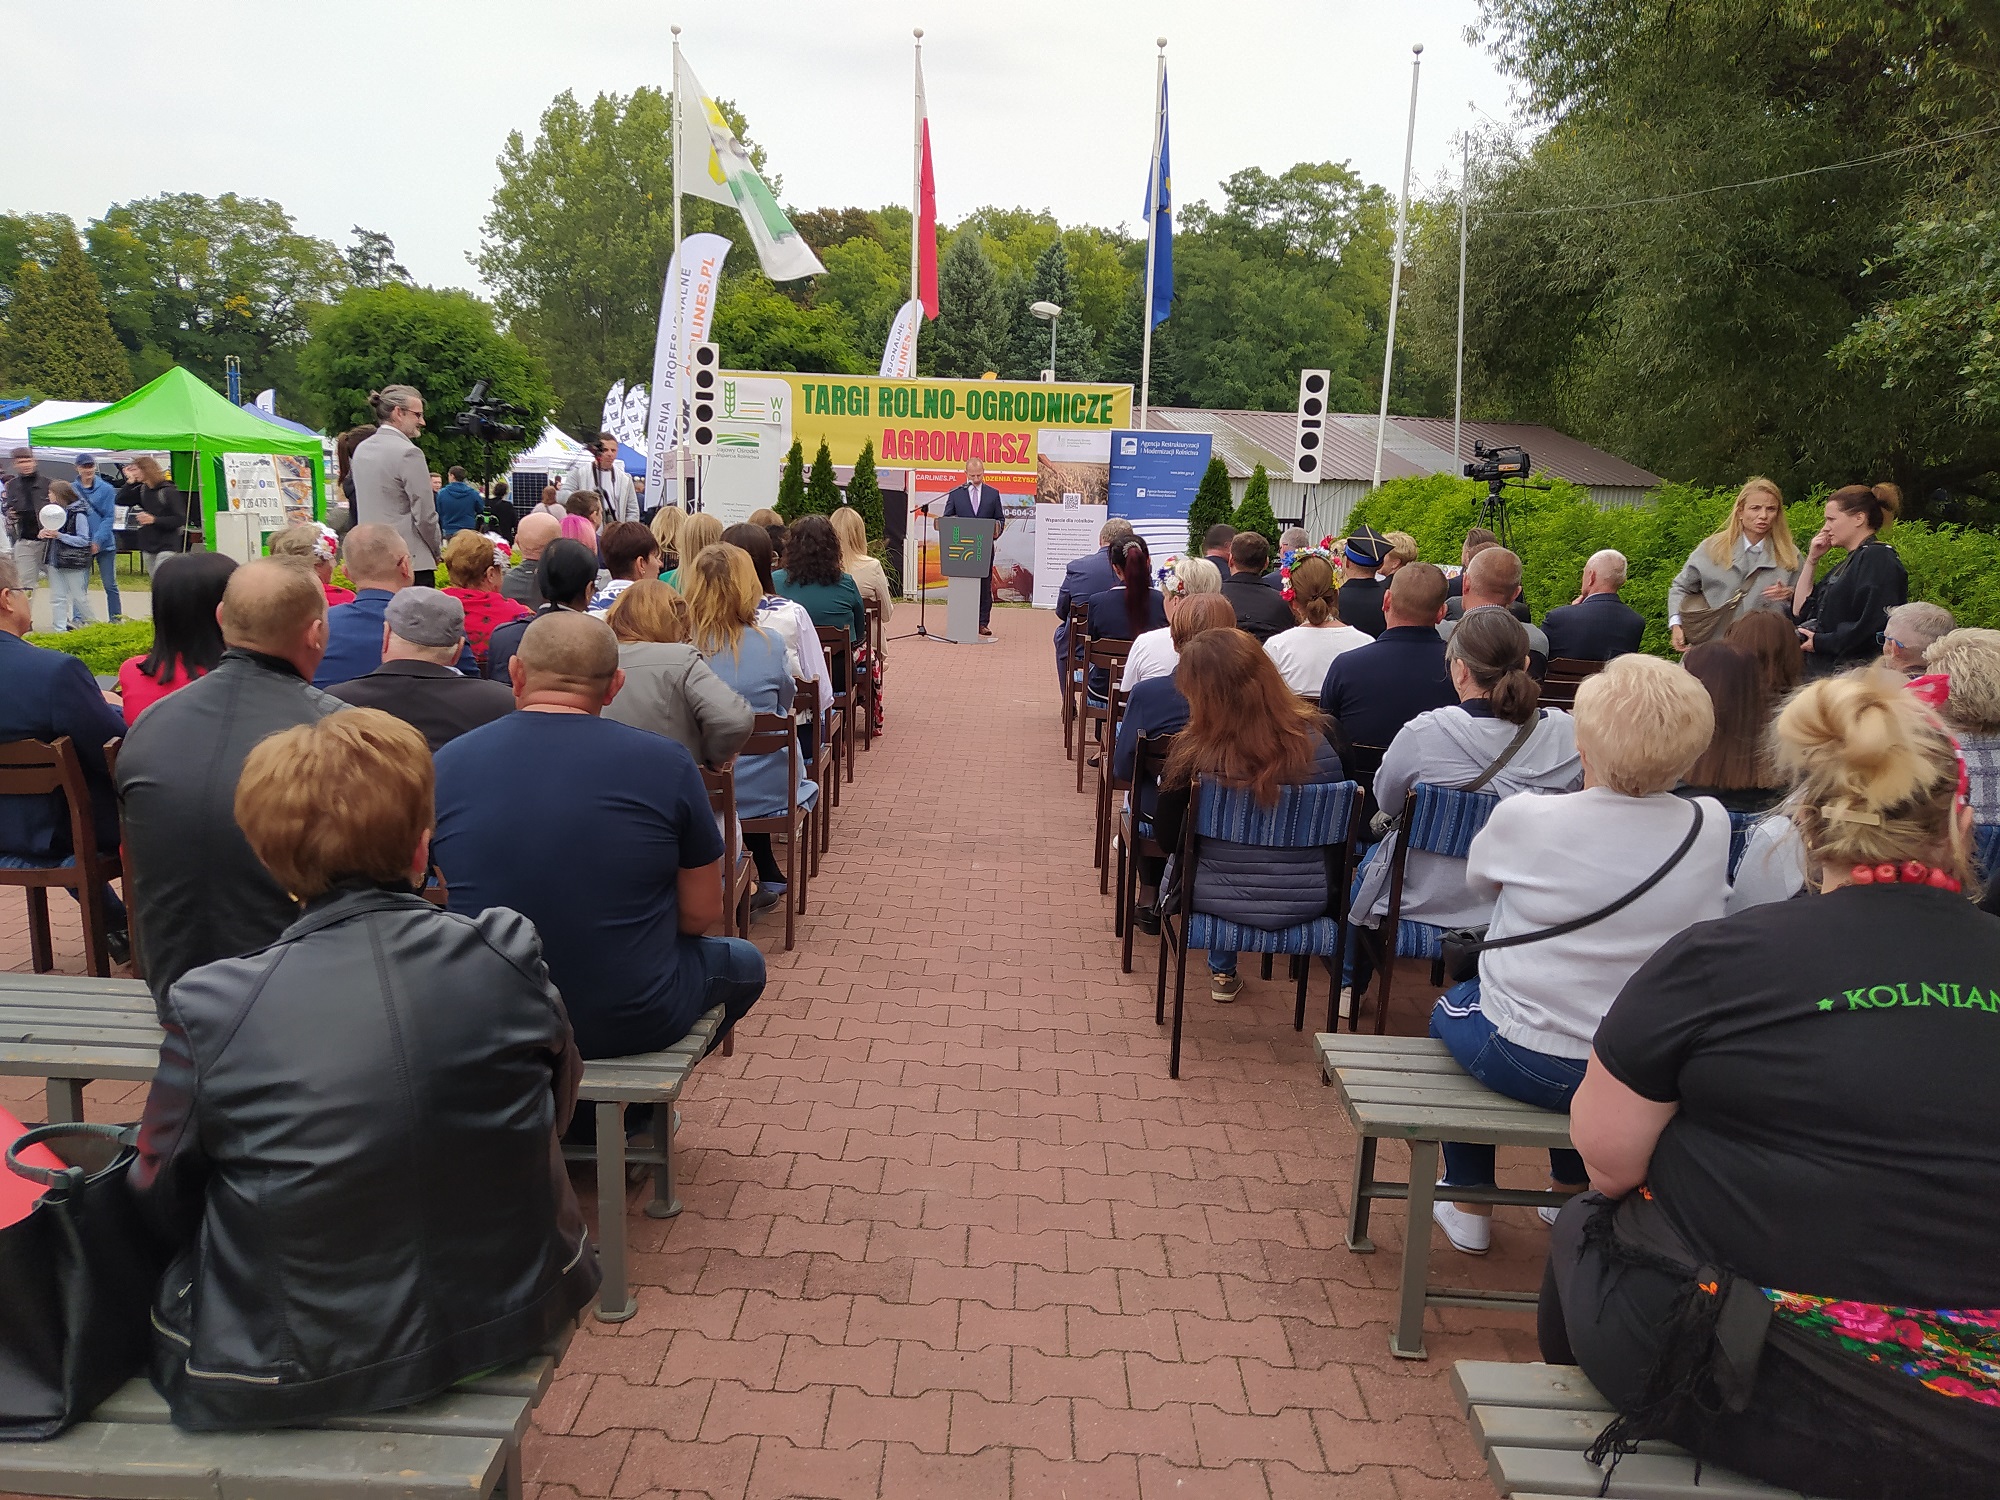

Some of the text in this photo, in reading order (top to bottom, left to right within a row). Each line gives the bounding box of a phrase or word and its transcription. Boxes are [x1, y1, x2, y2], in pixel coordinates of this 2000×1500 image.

[802, 384, 1114, 424] TARGI ROLNO-OGRODNICZE
[881, 428, 1031, 464] AGROMARSZ
[1140, 440, 1160, 448] Agencja
[915, 474, 957, 482] CARLINES.PL
